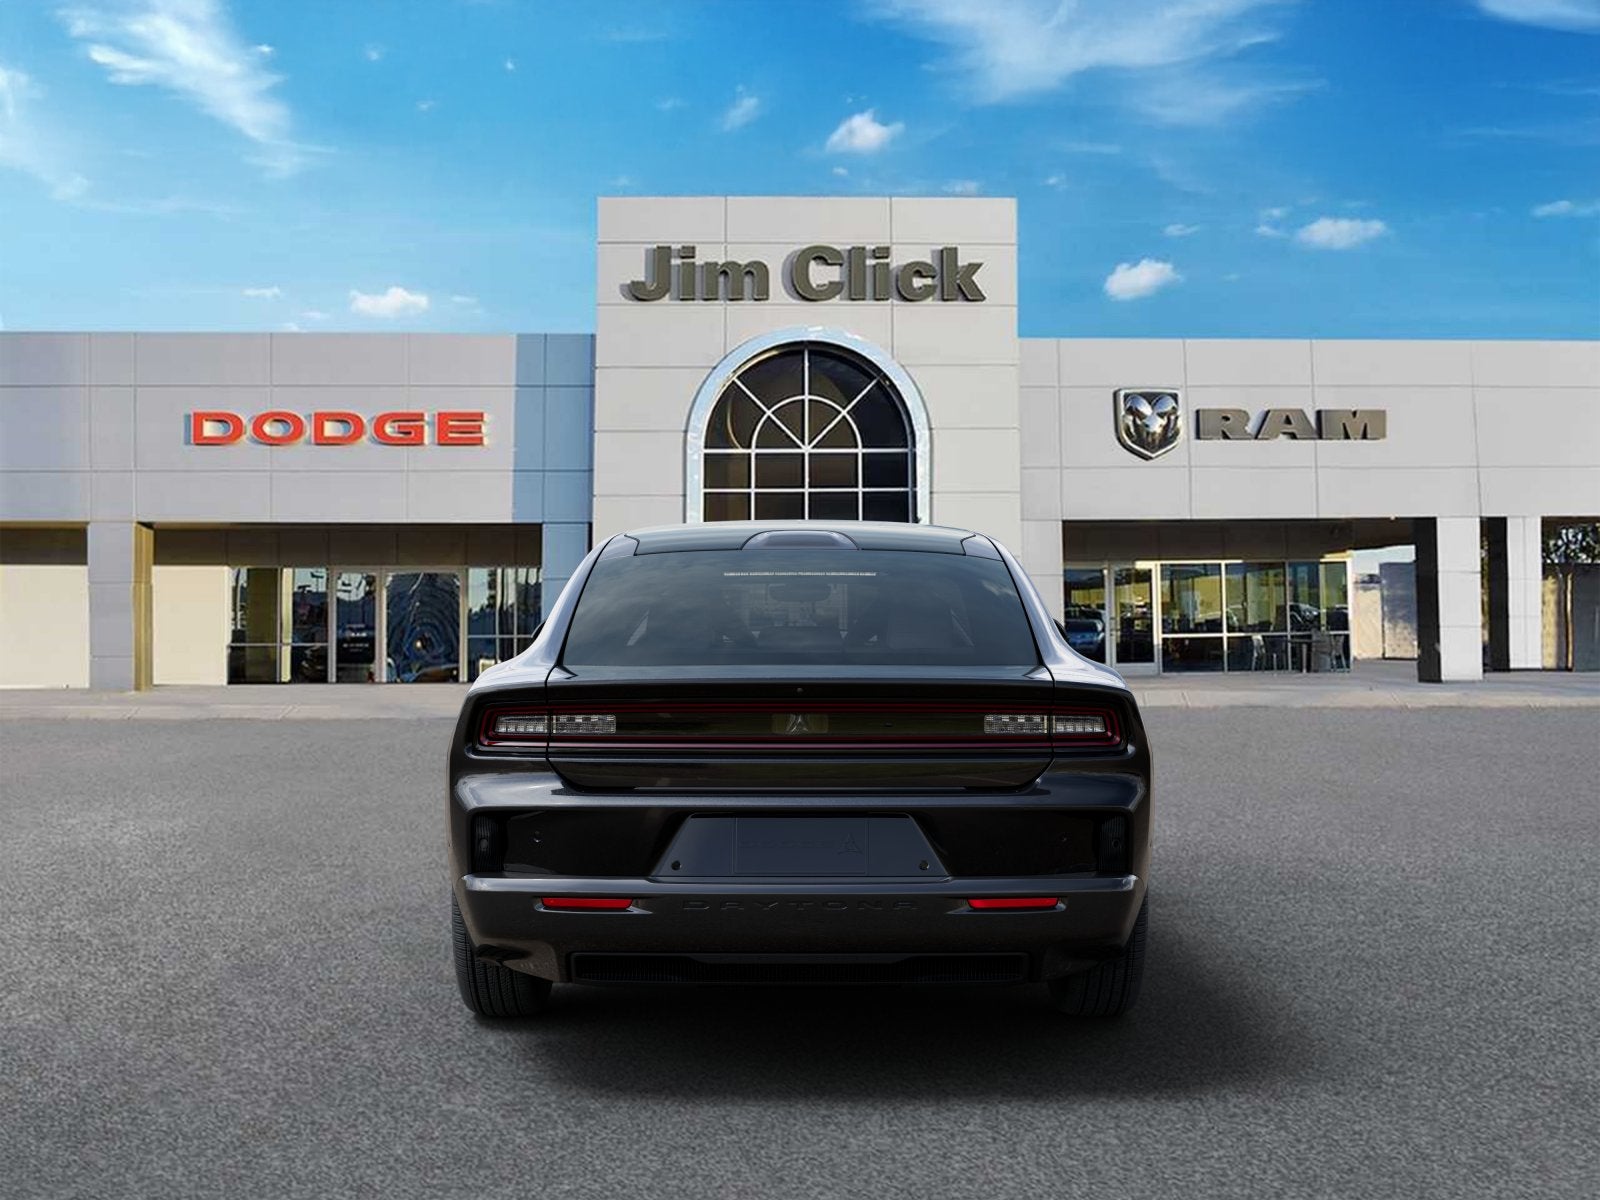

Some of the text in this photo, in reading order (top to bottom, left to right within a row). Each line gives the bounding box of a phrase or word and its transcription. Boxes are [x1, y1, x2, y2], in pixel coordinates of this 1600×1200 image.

[627, 244, 987, 302] Jim Click
[190, 411, 486, 446] DODGE
[1198, 408, 1387, 440] RAM
[682, 898, 920, 911] DAYTONA
